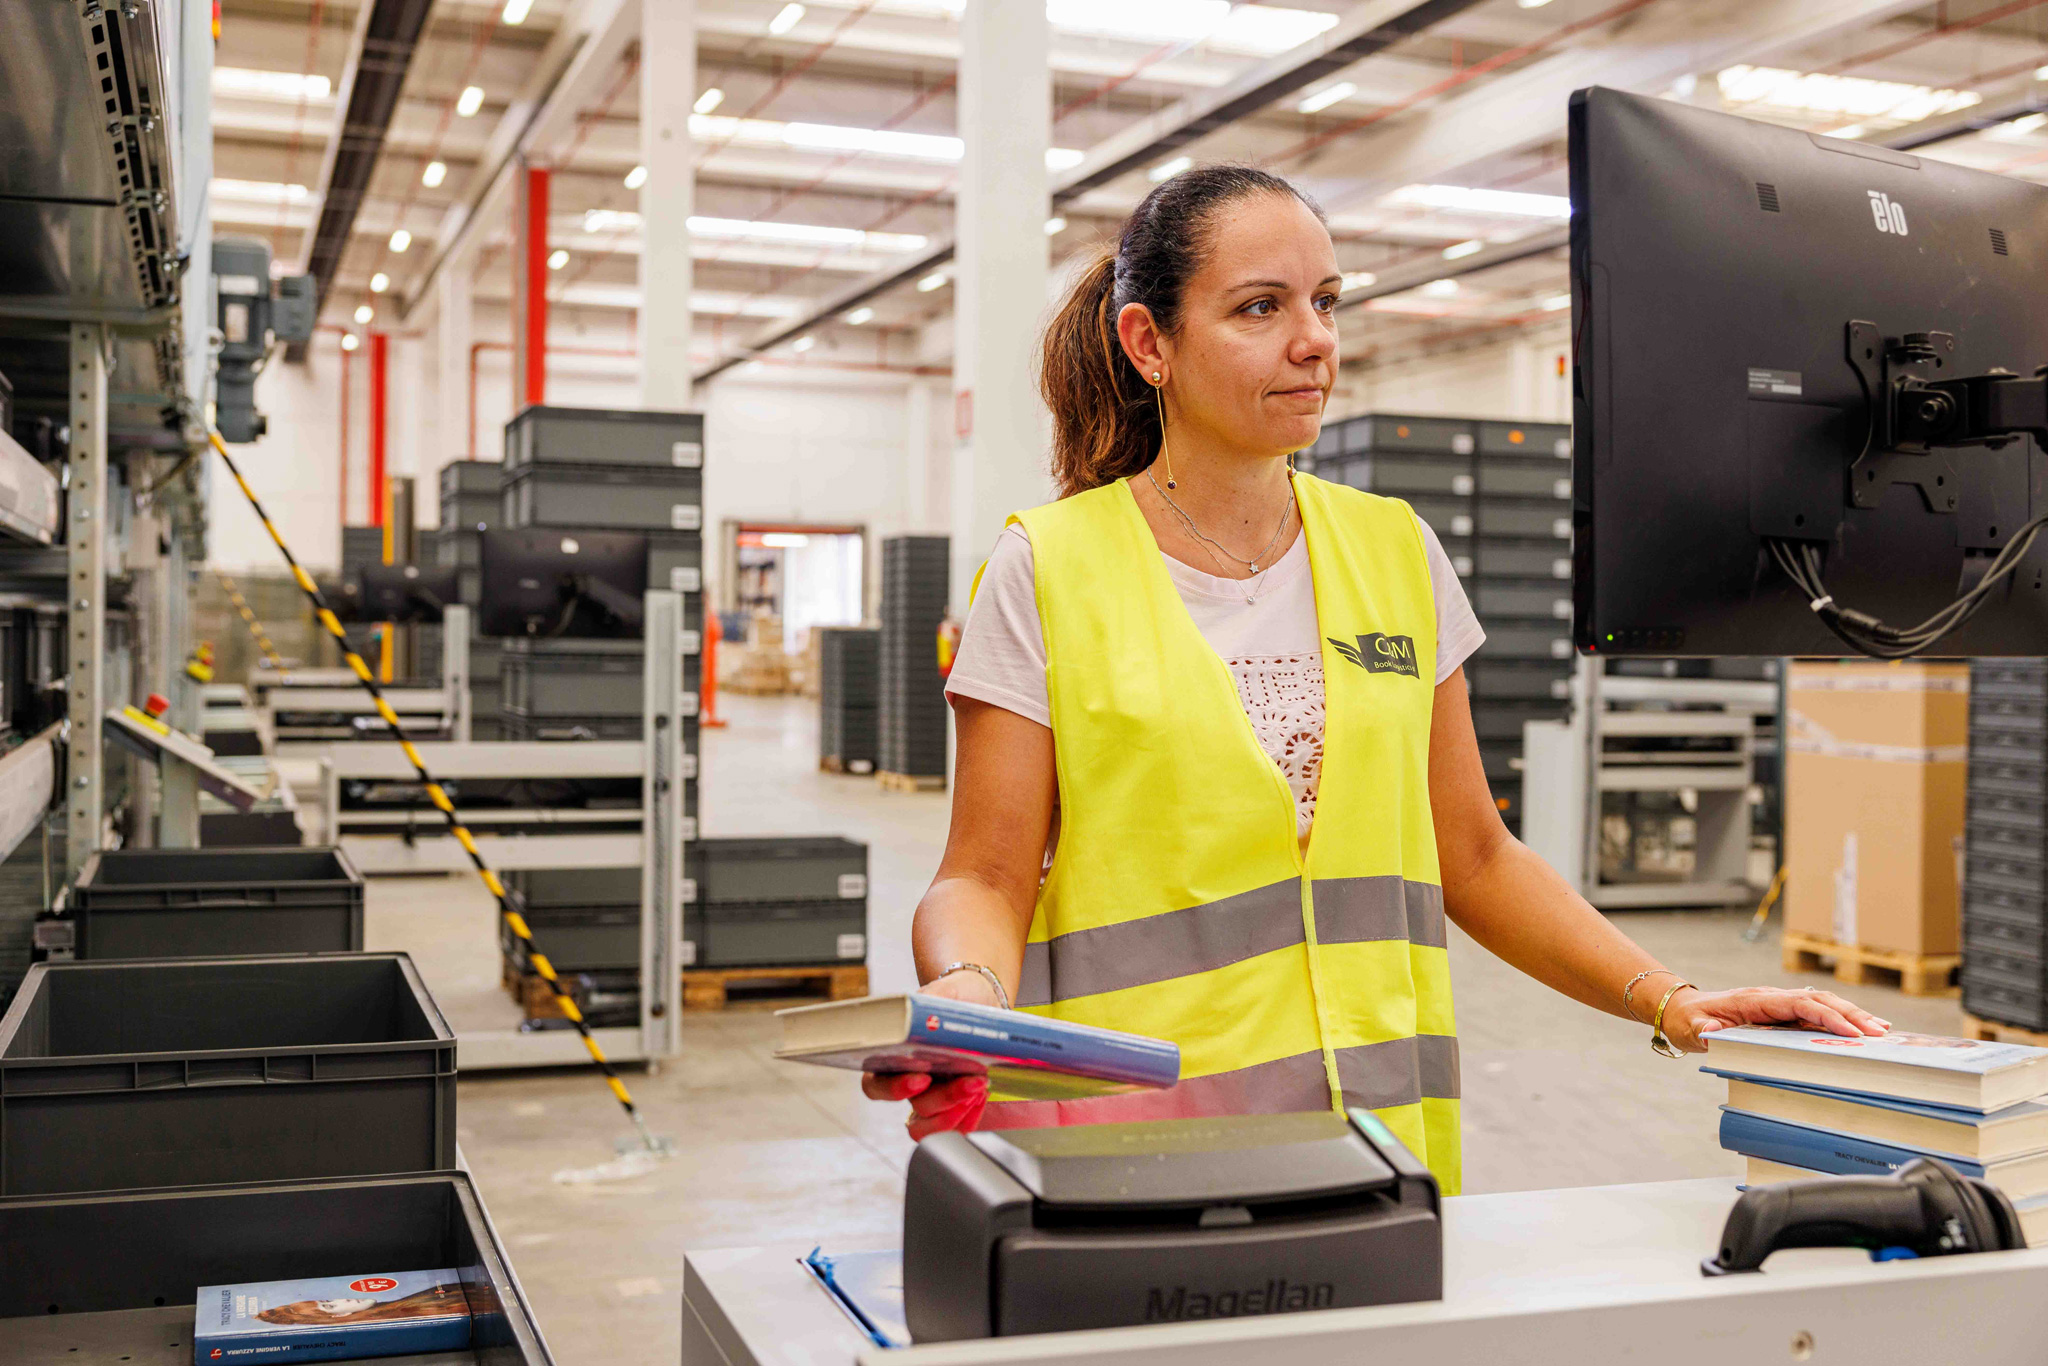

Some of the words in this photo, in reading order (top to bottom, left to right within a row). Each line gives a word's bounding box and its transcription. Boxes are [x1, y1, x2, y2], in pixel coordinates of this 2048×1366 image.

[1373, 660, 1392, 669] Book
[1834, 1151, 1854, 1160] TRACY
[1854, 1156, 1887, 1167] CHEVALIER
[1888, 1162, 1897, 1170] LA
[1146, 1277, 1335, 1321] Magellan
[255, 1346, 281, 1354] VERGINE
[292, 1343, 326, 1351] CHEVALIER
[226, 1348, 255, 1356] AZZURRA
